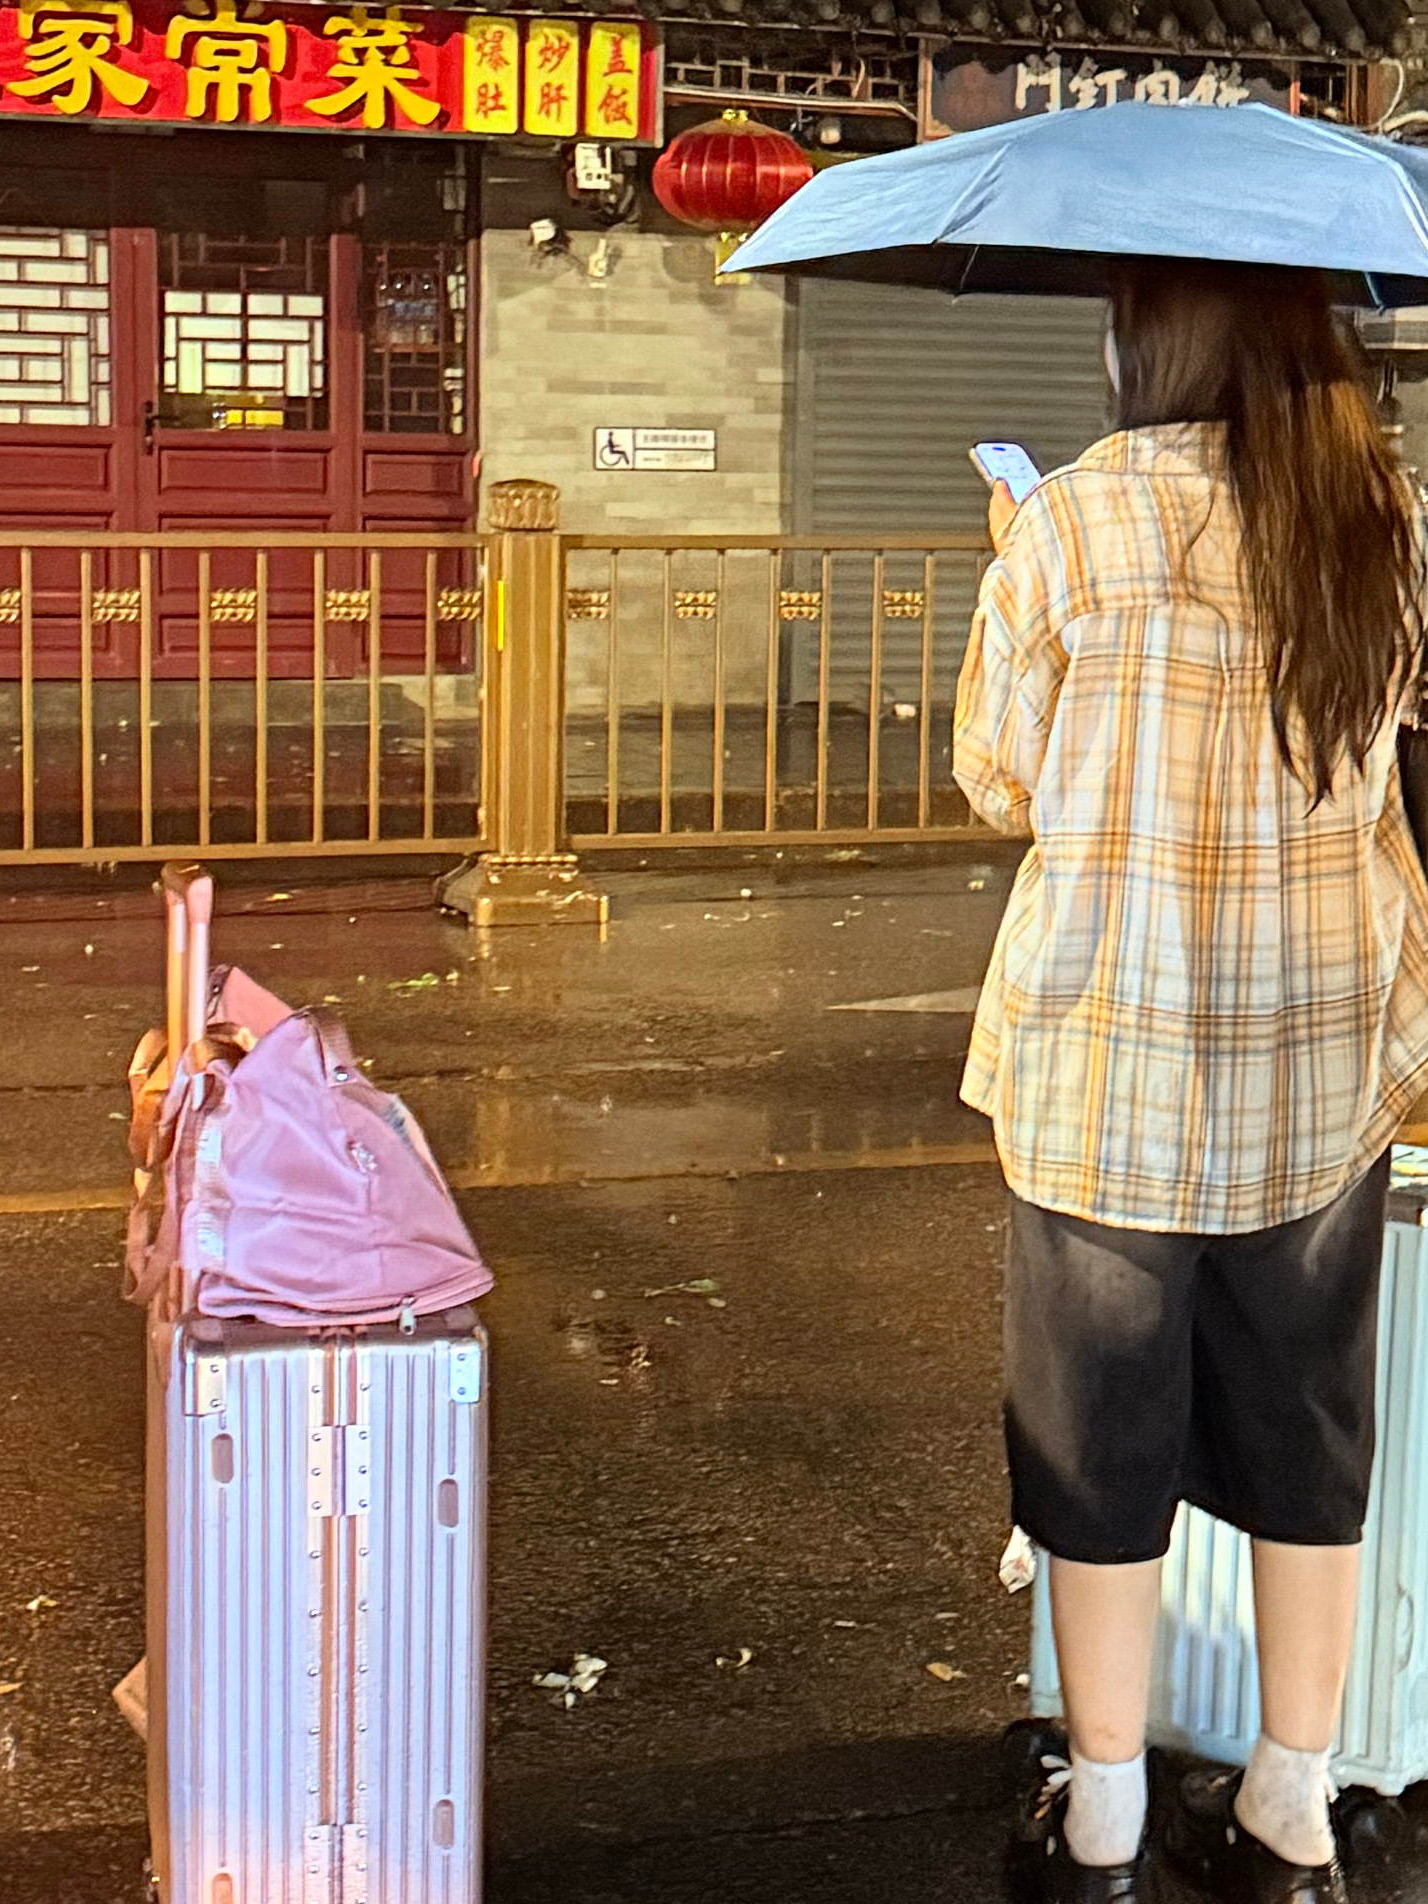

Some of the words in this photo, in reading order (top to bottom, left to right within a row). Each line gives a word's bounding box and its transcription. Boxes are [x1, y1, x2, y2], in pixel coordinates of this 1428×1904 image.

[476, 29, 510, 119] 爆肚
[538, 33, 570, 123] 炒肝
[598, 34, 634, 126] 盖饭
